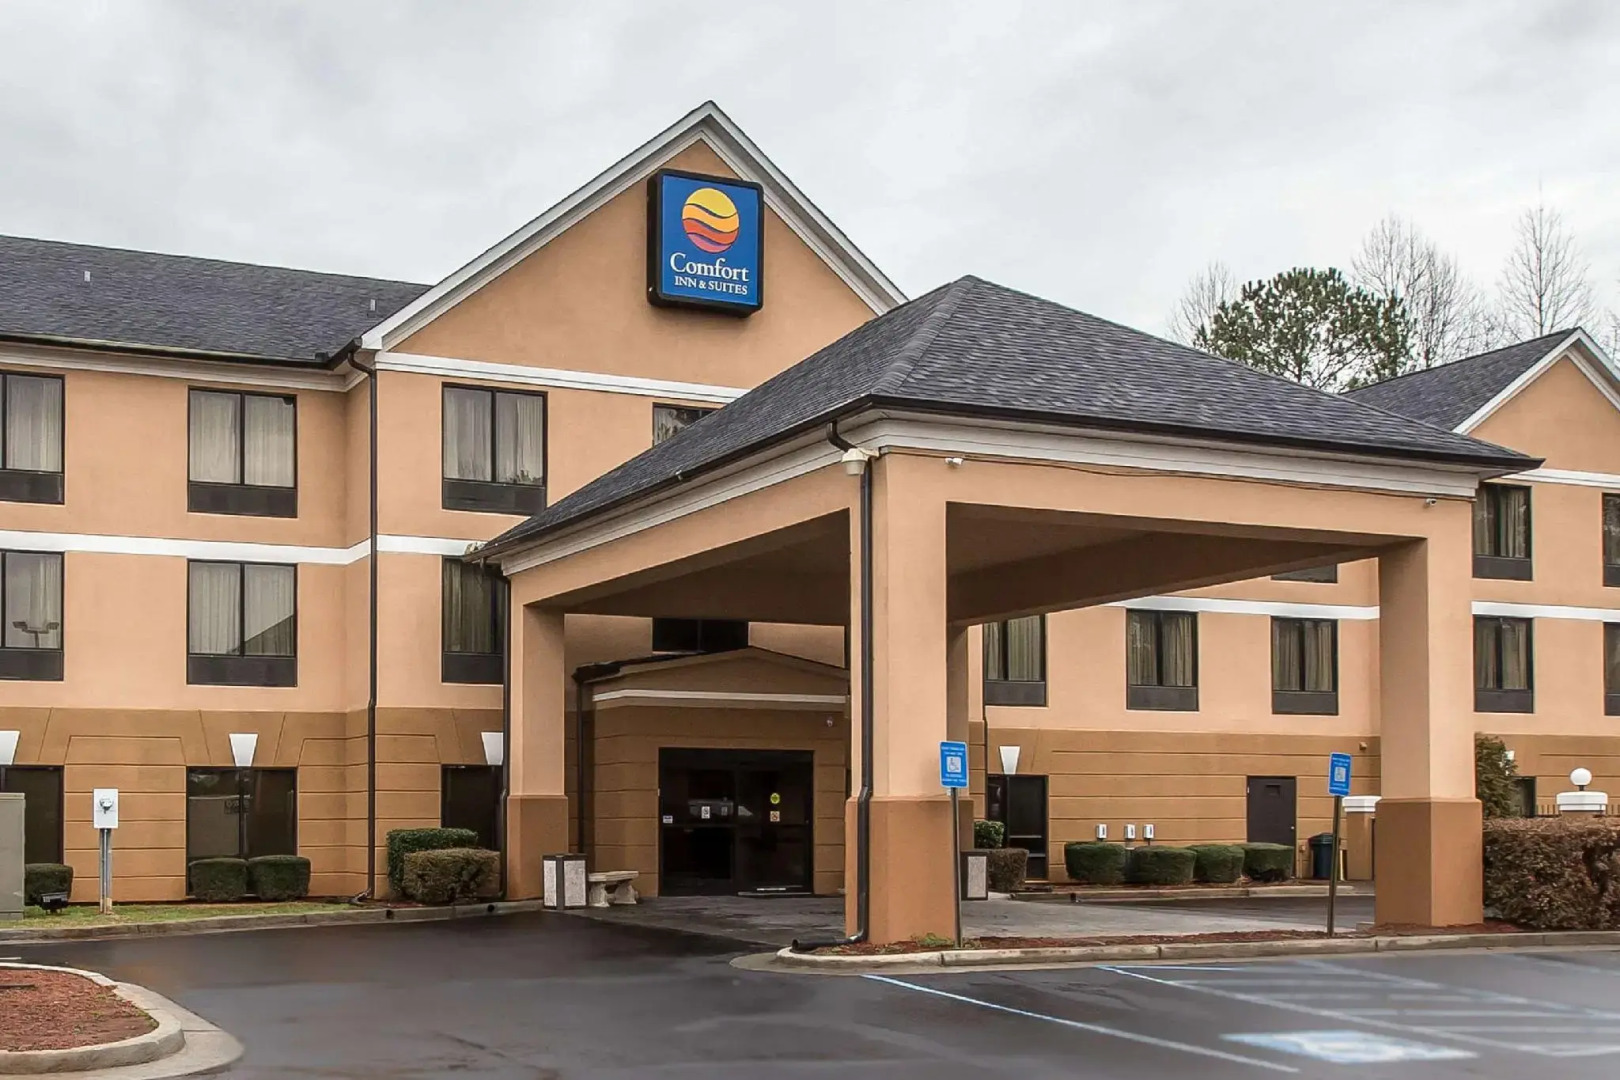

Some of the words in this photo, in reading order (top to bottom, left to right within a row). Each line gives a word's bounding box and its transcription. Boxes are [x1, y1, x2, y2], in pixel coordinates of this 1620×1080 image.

[670, 252, 749, 281] Comfort
[674, 276, 697, 288] INN
[698, 280, 706, 289] &
[708, 281, 748, 295] SUITES
